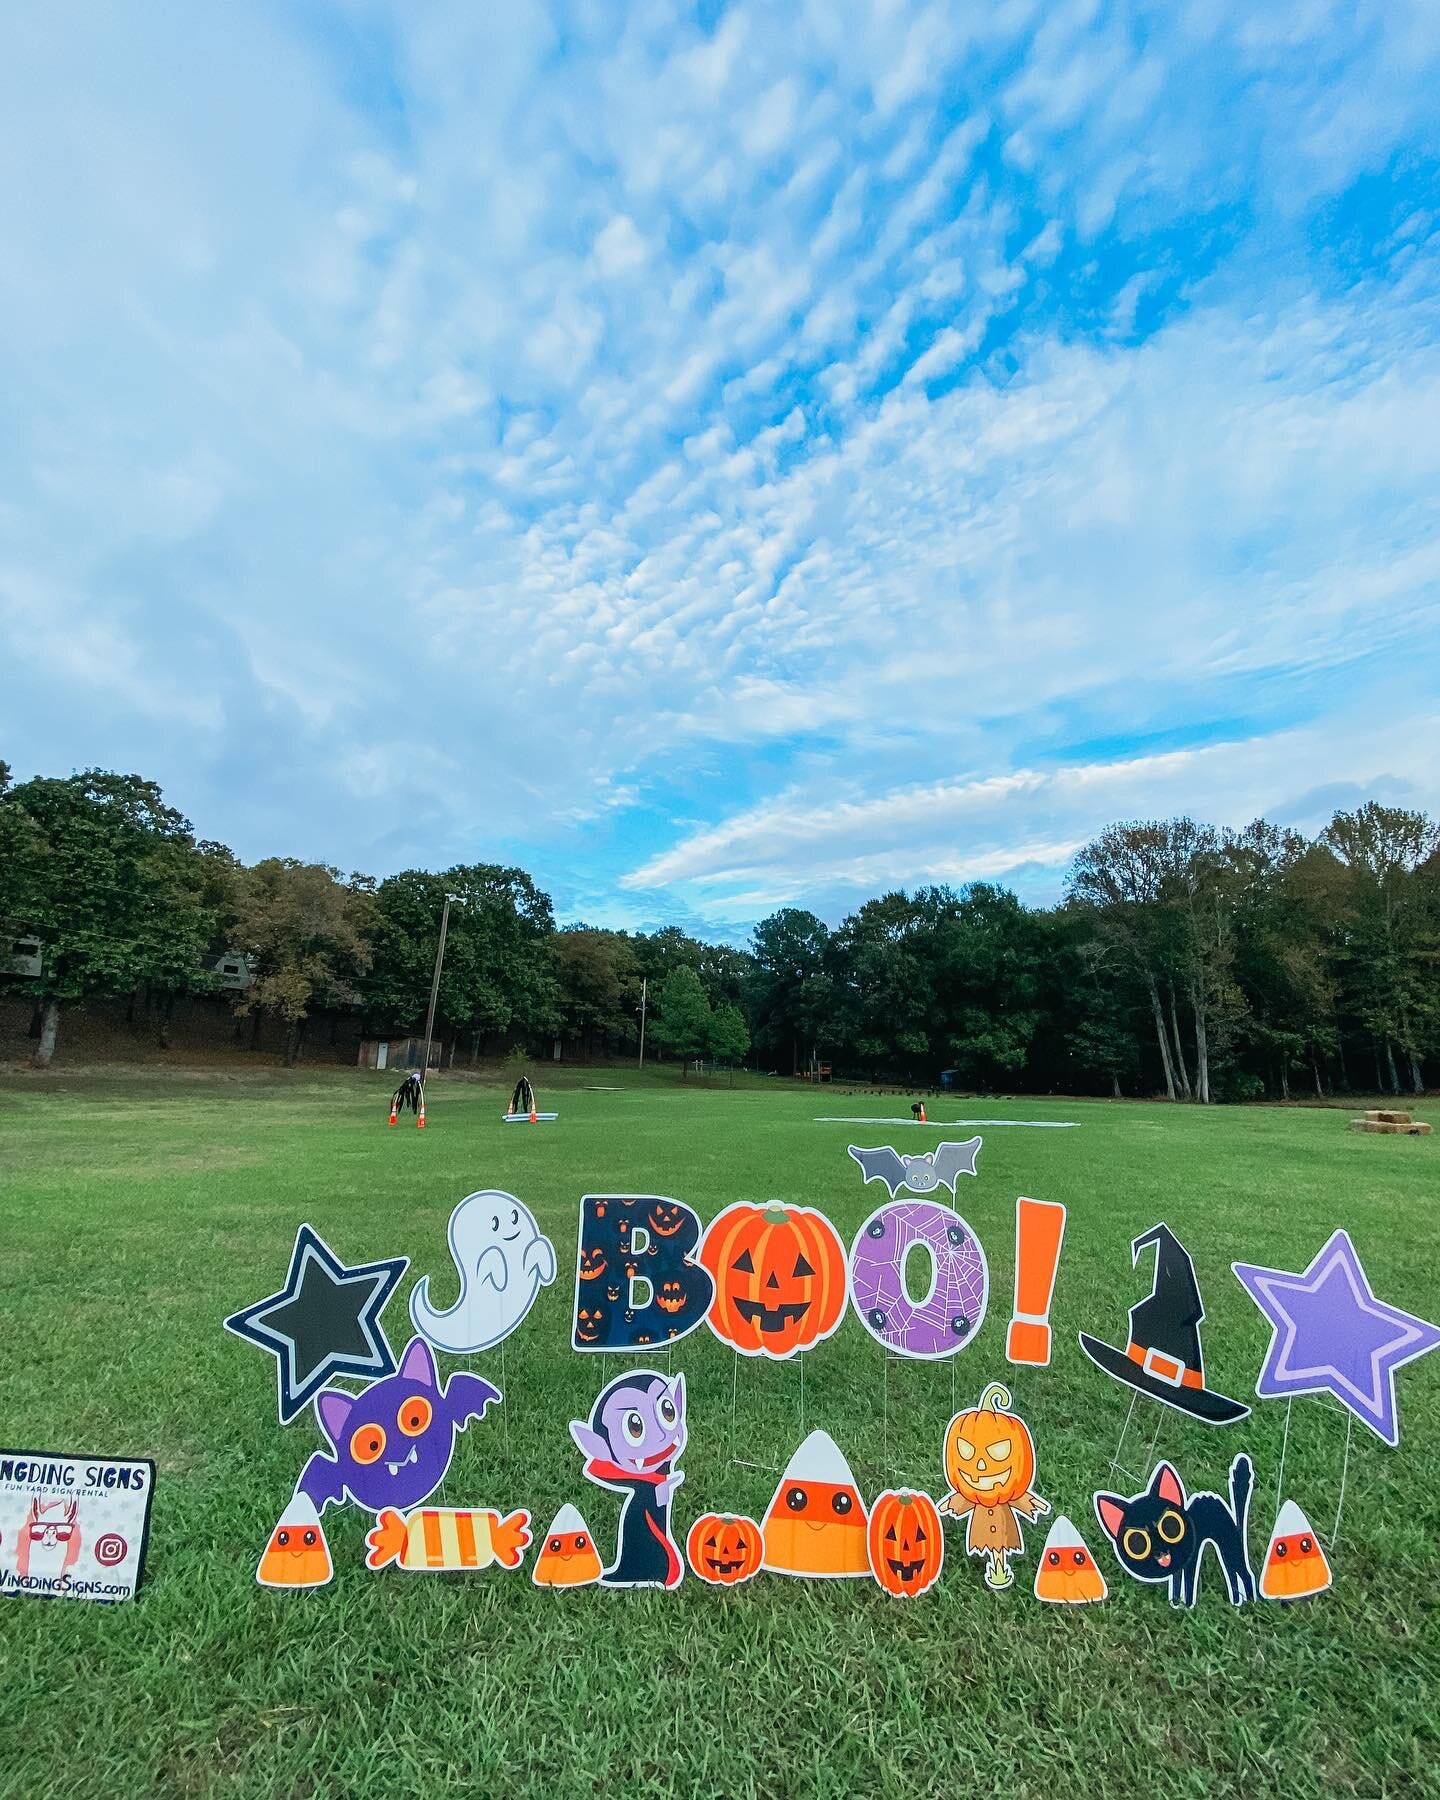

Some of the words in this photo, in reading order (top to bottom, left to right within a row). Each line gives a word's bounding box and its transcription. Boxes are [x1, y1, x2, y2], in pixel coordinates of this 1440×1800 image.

[85, 1467, 145, 1491] SIGNS
[4, 1483, 24, 1492] FUN
[25, 1486, 49, 1495] YARD
[51, 1488, 75, 1496] SIGN
[75, 1489, 109, 1498] RENTAL
